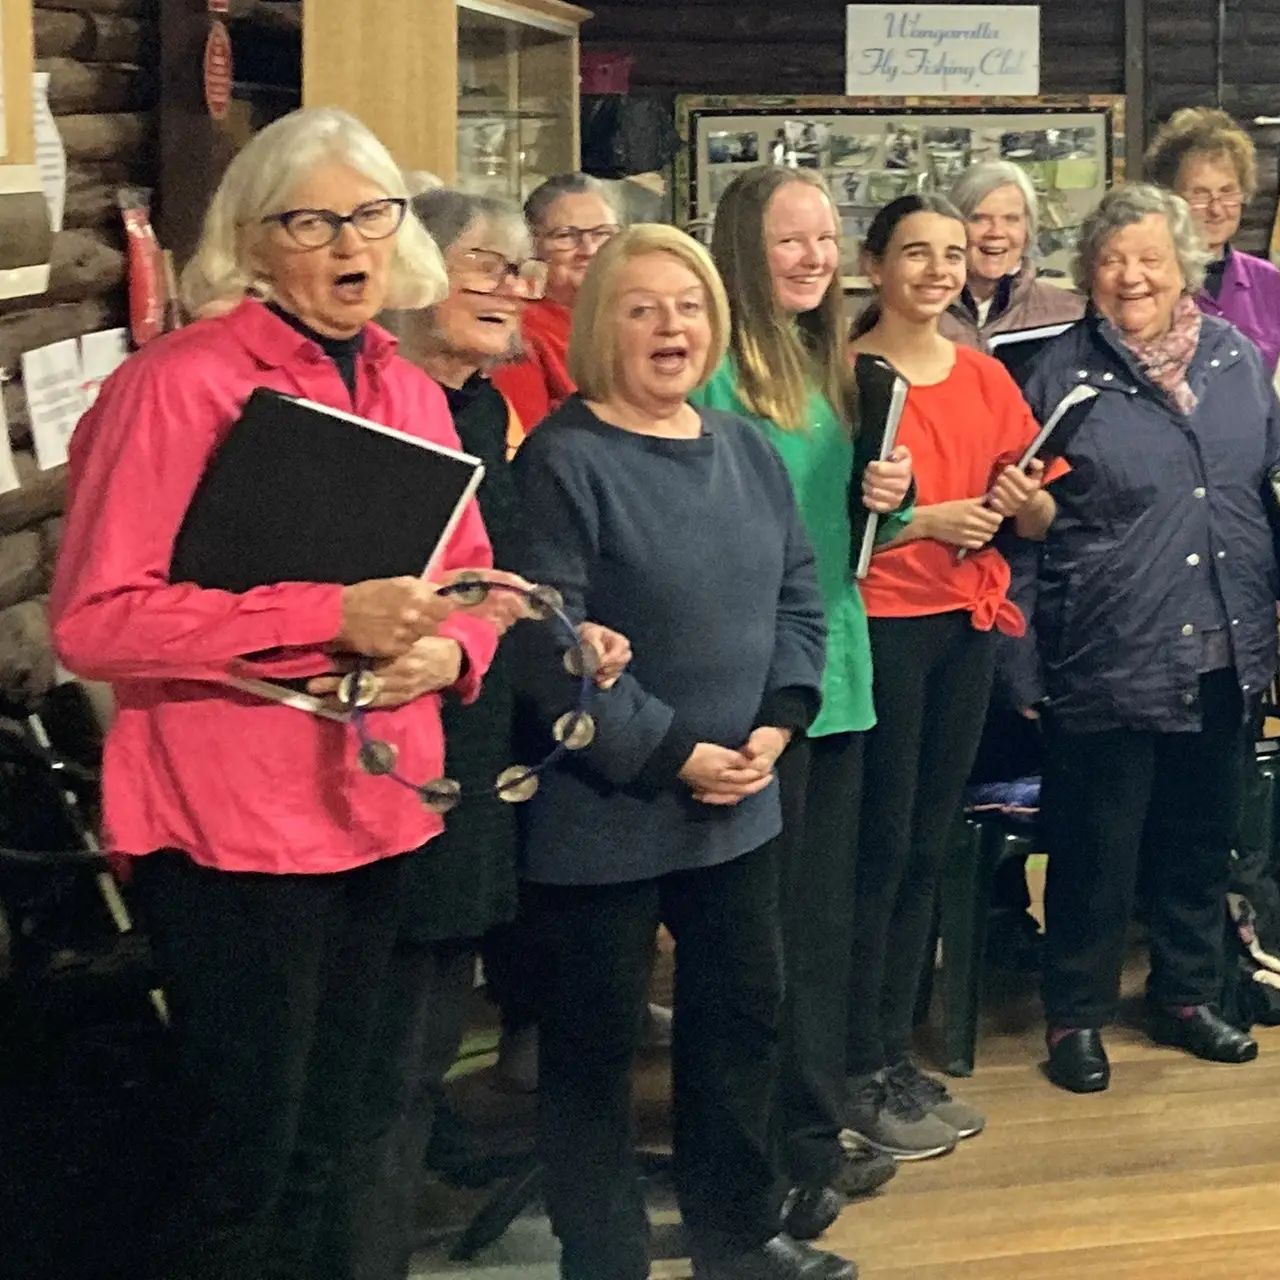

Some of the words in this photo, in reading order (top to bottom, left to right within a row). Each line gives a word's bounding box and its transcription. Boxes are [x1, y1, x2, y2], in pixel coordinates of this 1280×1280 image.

[885, 12, 999, 47] Wangaratta
[860, 48, 898, 82] Fly
[902, 48, 975, 82] Fishing
